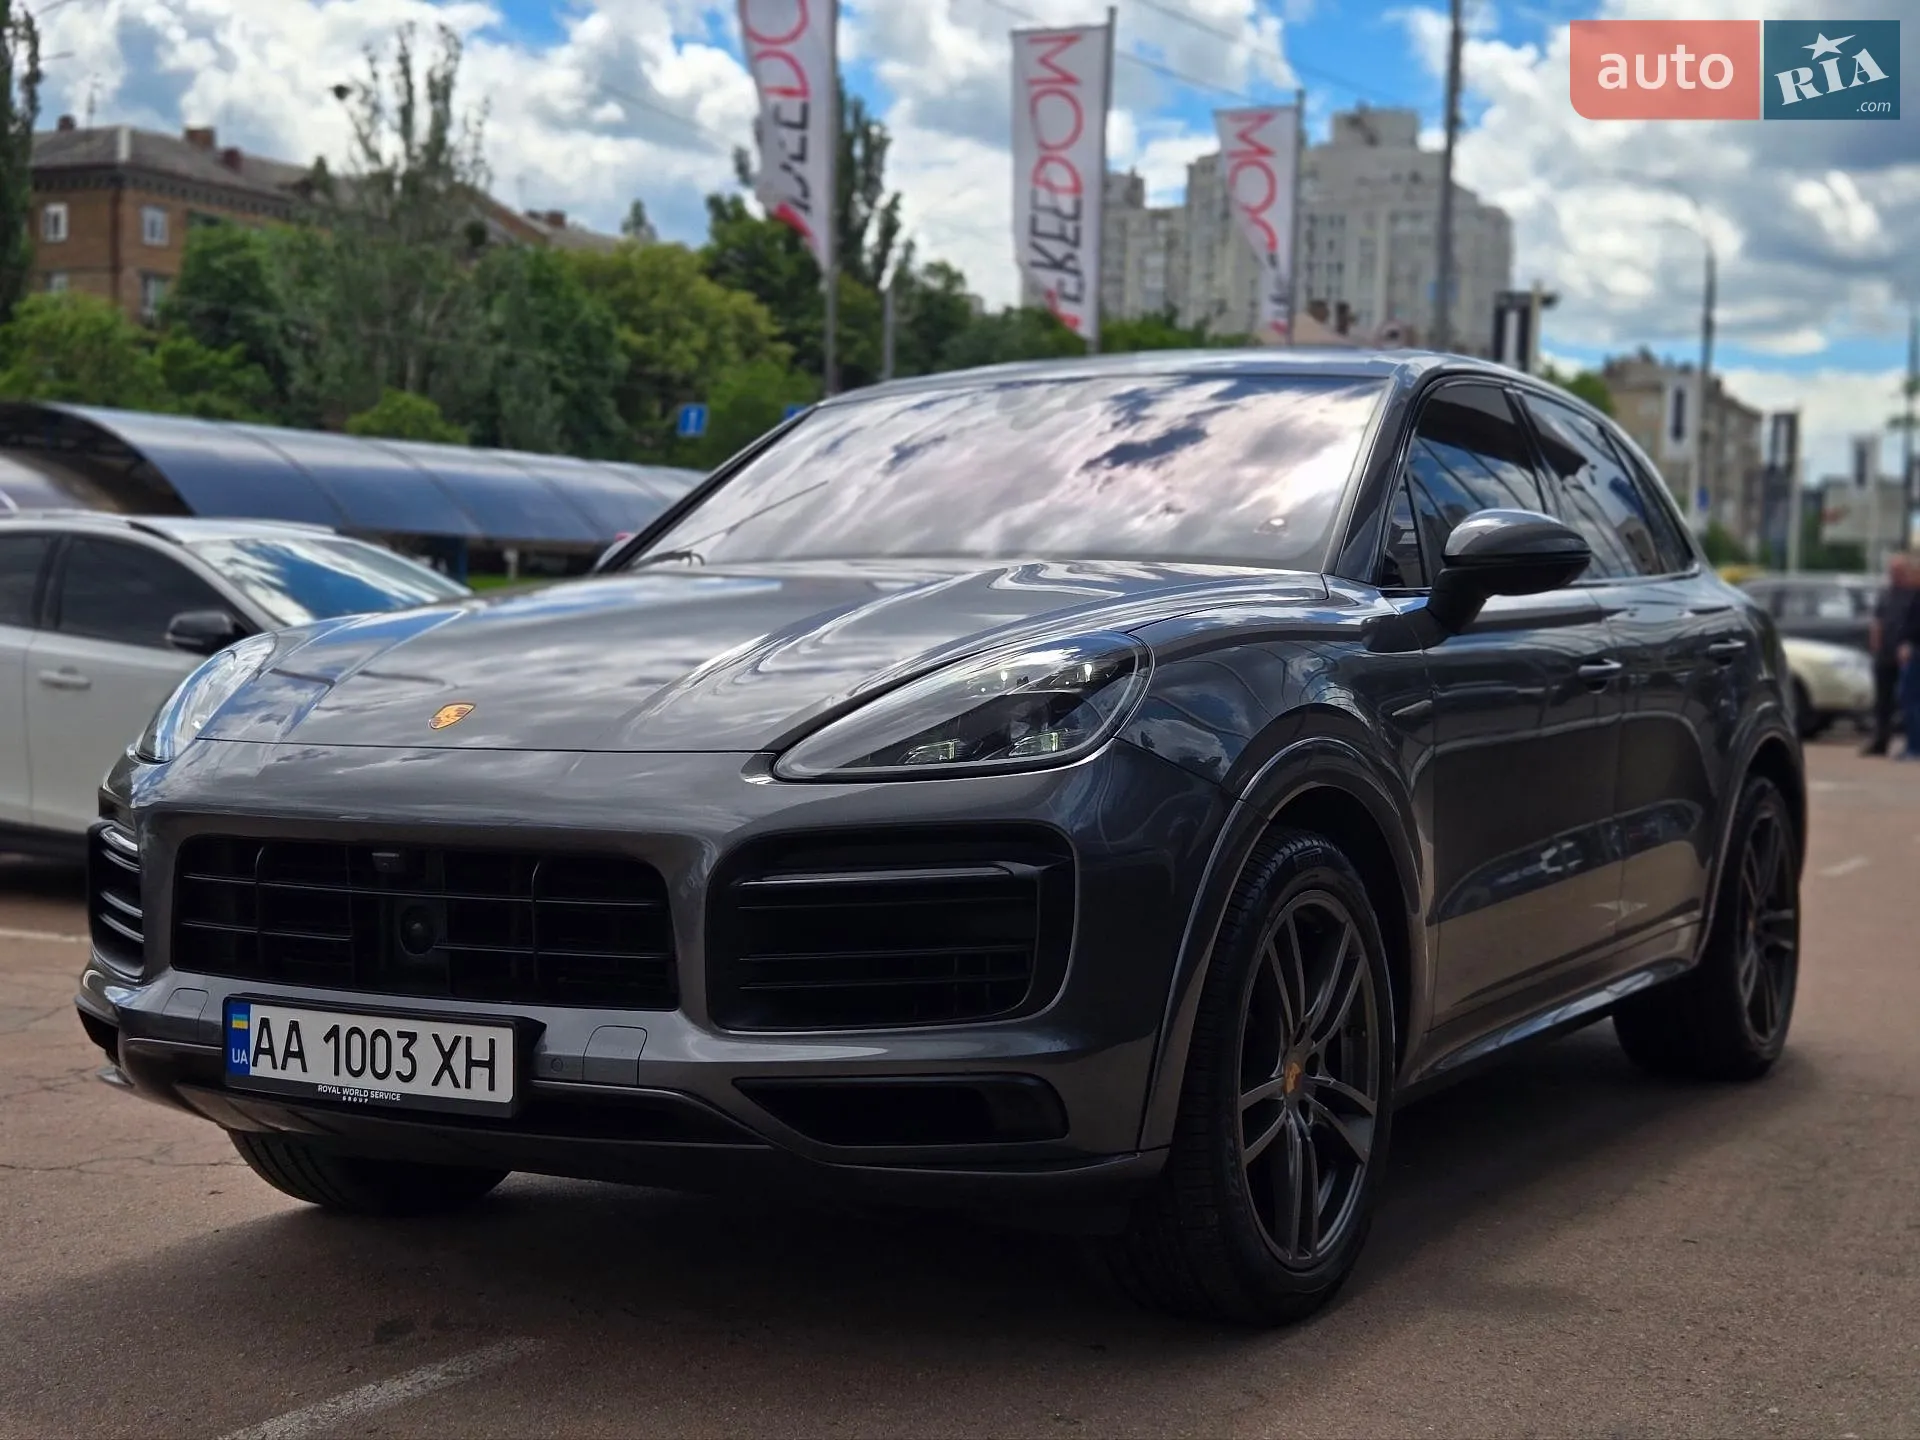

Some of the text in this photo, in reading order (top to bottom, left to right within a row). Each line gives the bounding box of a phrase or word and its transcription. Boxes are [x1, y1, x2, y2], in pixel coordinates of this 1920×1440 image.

[231, 1048, 249, 1065] UA
[252, 1017, 496, 1092] AA 1003 XH
[317, 1084, 401, 1101] ROYAL WORLD SERVICE
[342, 1095, 369, 1104] GROUP
